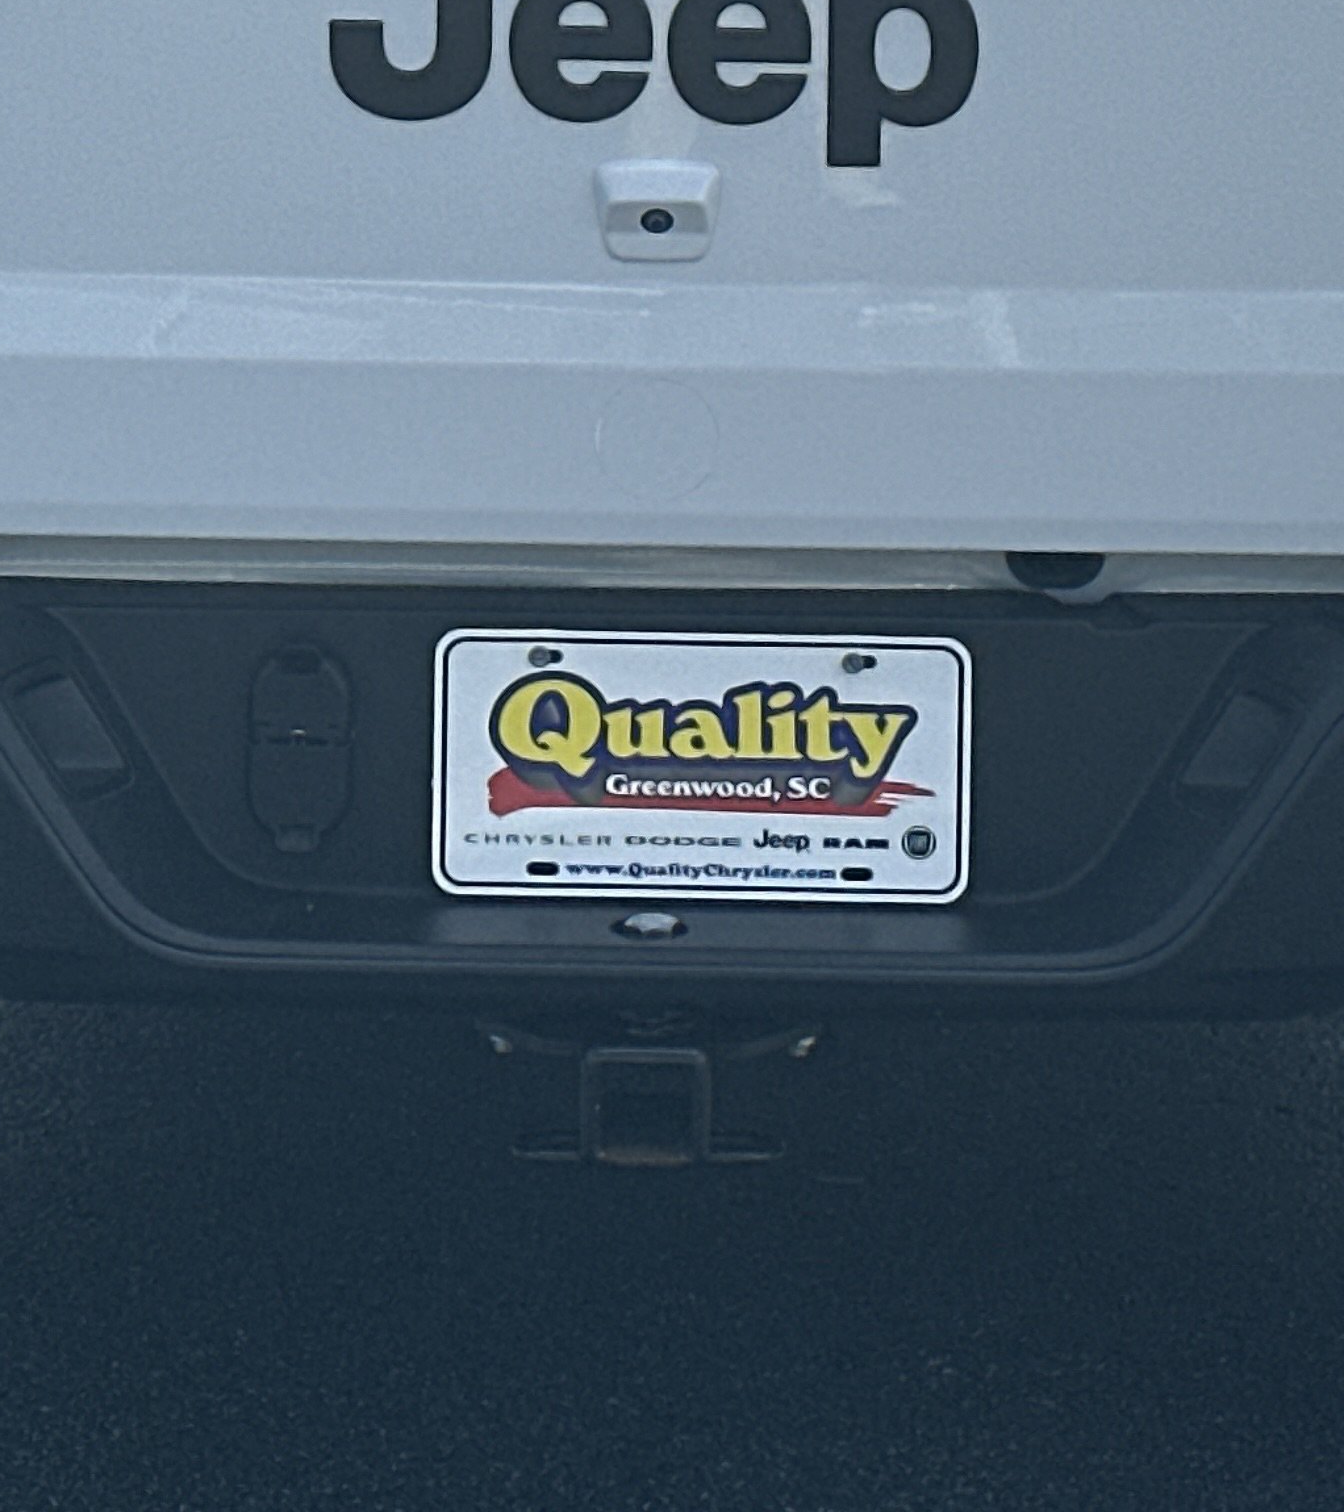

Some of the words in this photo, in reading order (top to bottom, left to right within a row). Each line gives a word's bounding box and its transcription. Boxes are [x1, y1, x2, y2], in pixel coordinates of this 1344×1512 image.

[492, 671, 915, 781] Quality
[605, 774, 782, 802] Greenwood,
[786, 776, 831, 799] SC
[464, 833, 613, 846] CHRYSLER
[624, 835, 742, 847] DODGE
[753, 829, 811, 853] Jeep
[823, 837, 890, 850] RAM
[565, 861, 837, 881] www.QualityChrysler.com
